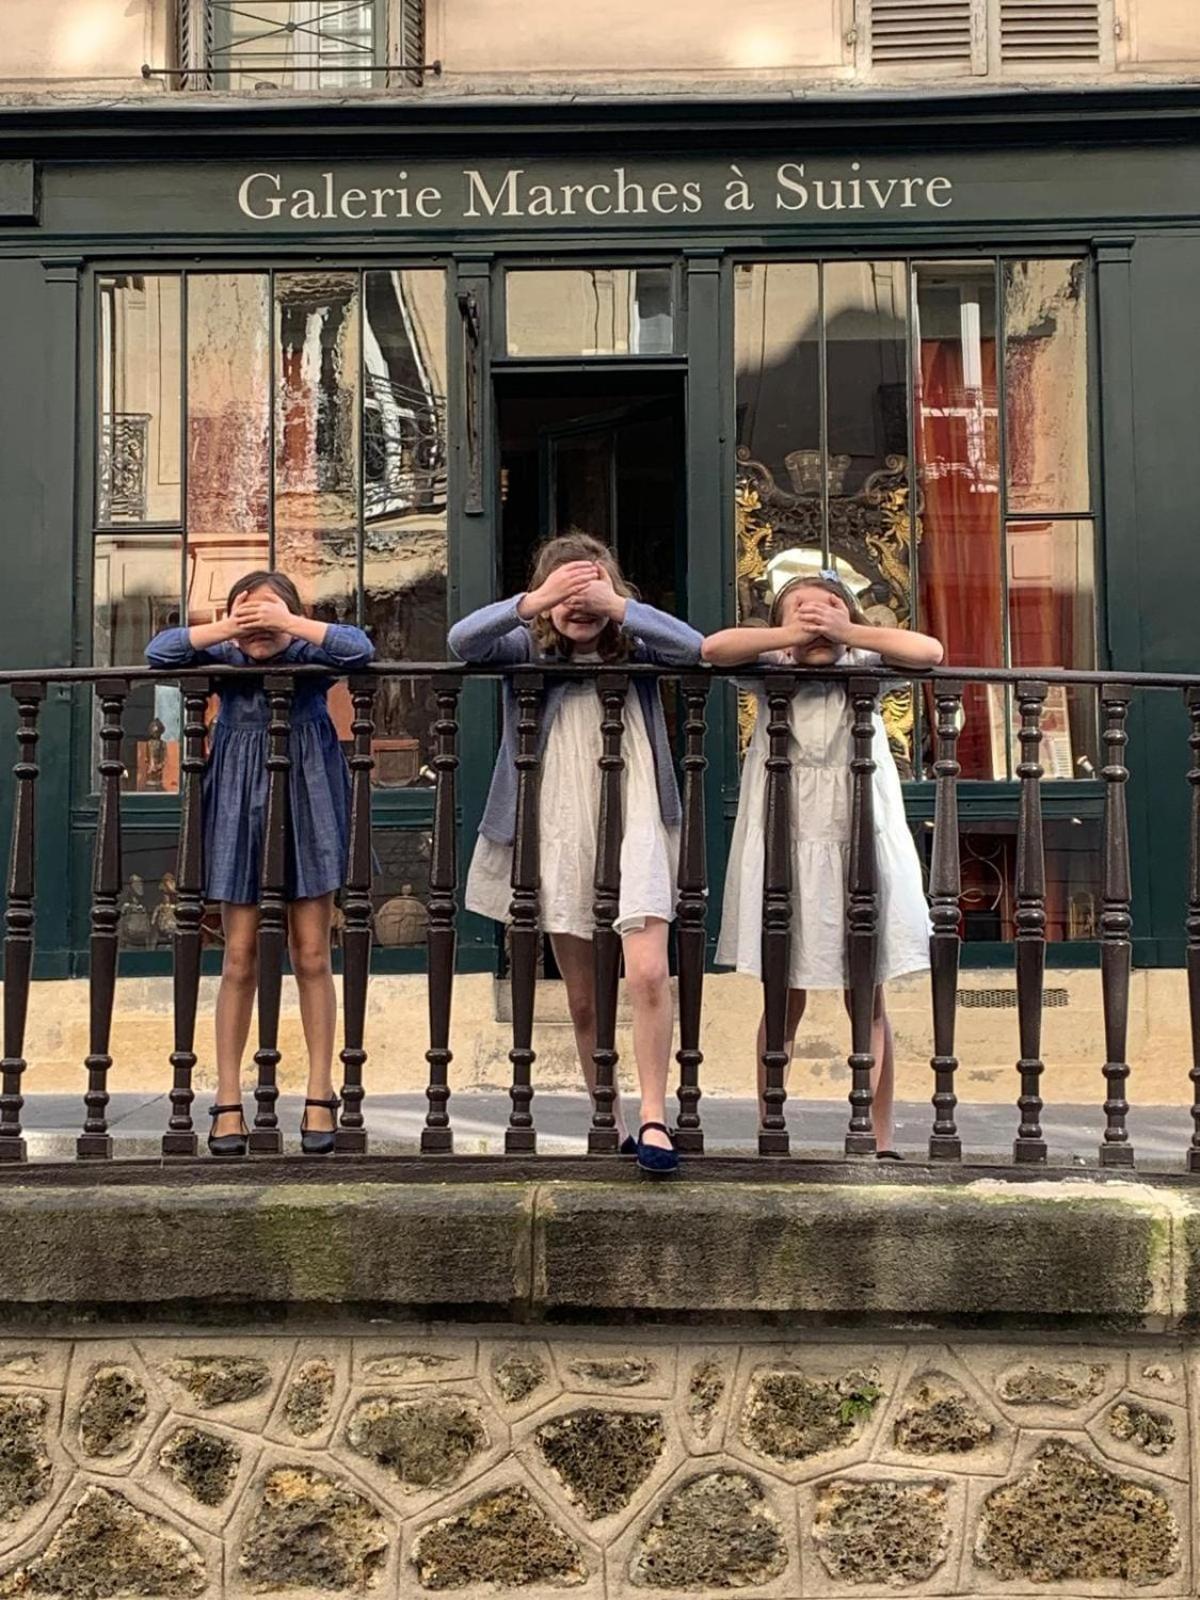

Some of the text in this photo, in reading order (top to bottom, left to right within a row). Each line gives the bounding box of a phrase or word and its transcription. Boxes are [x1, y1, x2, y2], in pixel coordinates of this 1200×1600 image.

[237, 162, 954, 220] Galerie Marches à Suivre
